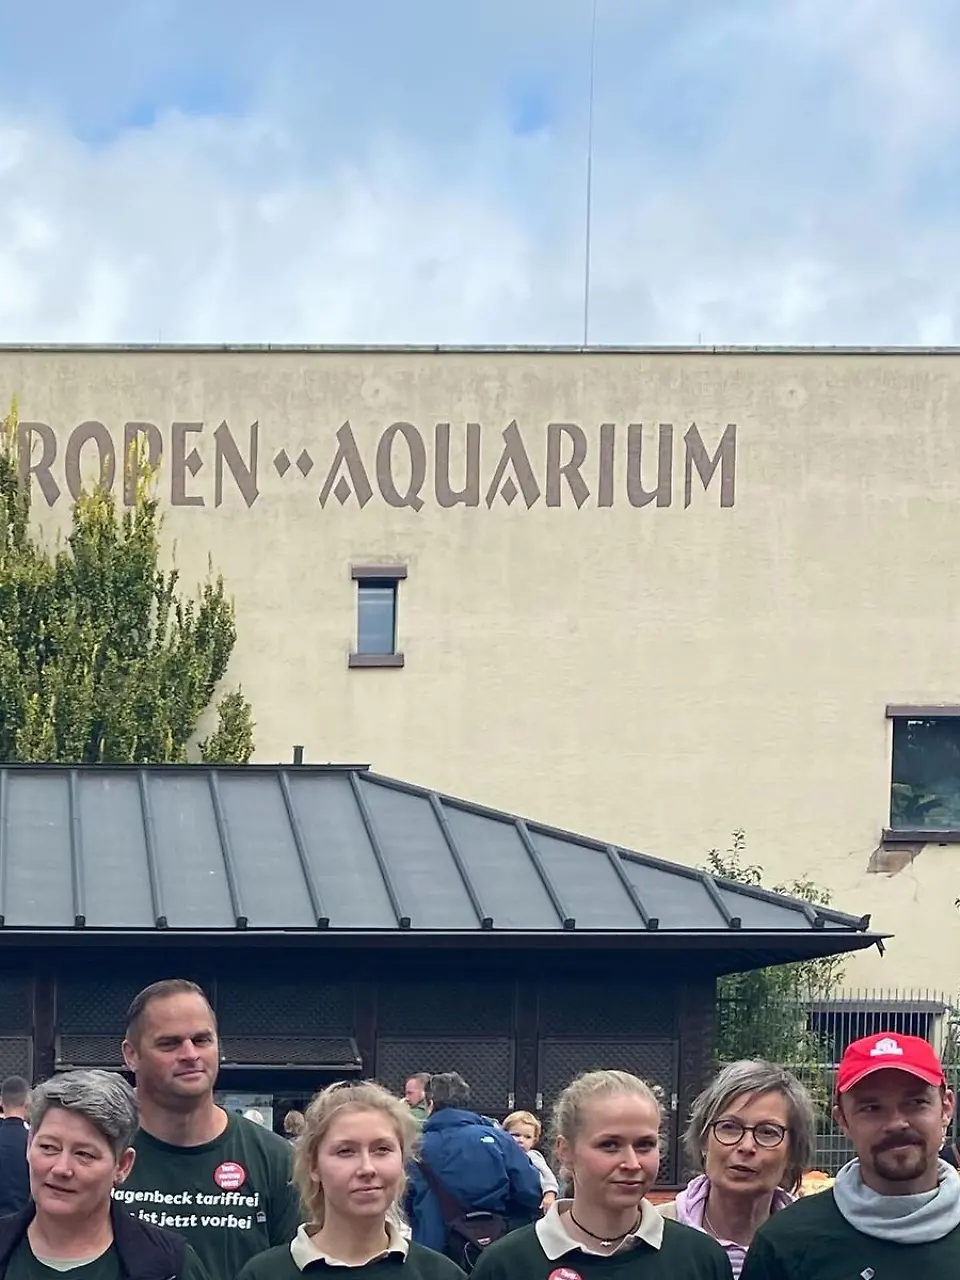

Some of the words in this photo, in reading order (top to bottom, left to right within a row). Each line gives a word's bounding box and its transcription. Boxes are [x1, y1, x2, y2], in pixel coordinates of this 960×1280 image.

[318, 419, 737, 511] AQUARIUM
[195, 1191, 259, 1207] tariffrei
[157, 1213, 197, 1227] jetzt
[201, 1215, 252, 1229] vorbei
